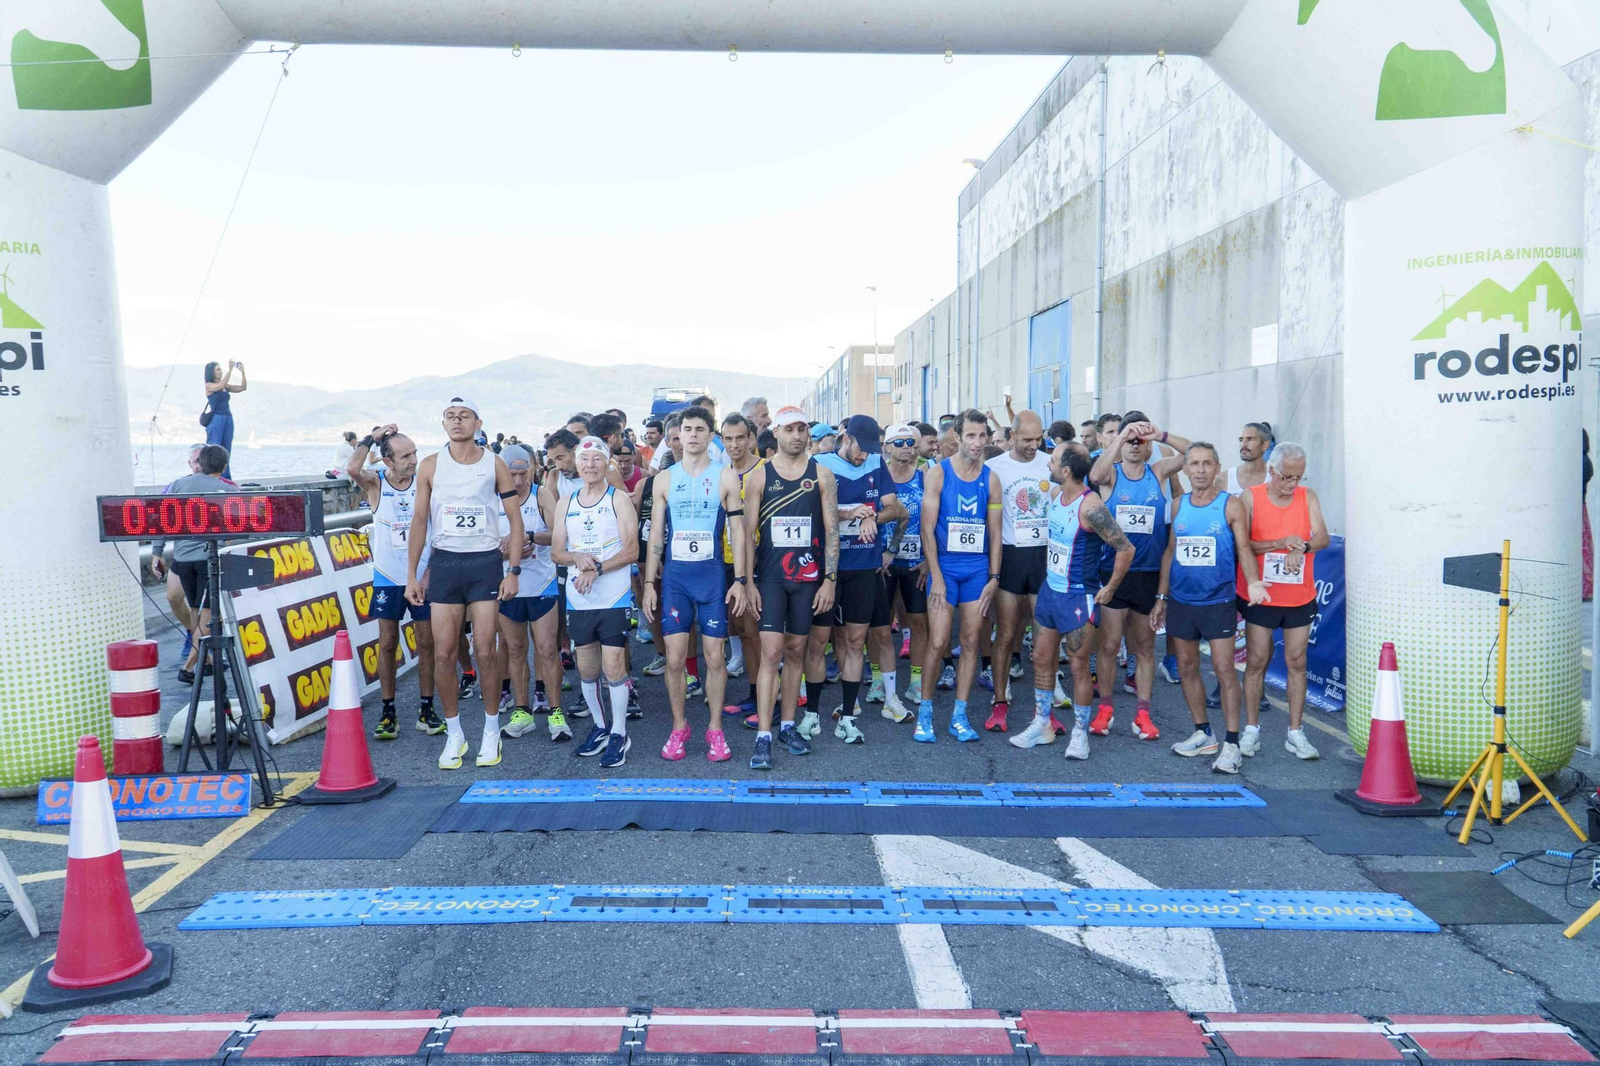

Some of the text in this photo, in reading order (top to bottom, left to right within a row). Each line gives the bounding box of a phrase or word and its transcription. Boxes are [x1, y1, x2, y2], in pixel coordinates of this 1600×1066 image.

[1414, 333, 1582, 383] rodespi
[1438, 382, 1575, 403] www.rodespi.es
[122, 496, 273, 534] 0:00:00
[455, 515, 477, 528] 23
[1128, 514, 1147, 526] 34
[784, 526, 801, 539] 11
[959, 532, 976, 545] 66
[689, 541, 699, 554] 6
[901, 542, 918, 553] 43
[1183, 546, 1211, 558] 152
[286, 596, 342, 642] GADIS
[252, 891, 338, 900] CRONOTEC
[601, 887, 684, 895] CRONOTEC
[943, 889, 1024, 897] CRONOTEC
[379, 899, 541, 912] CRONOTEC
[1084, 903, 1241, 915] CRONOTEC
[1257, 905, 1414, 918] CRONOTEC
